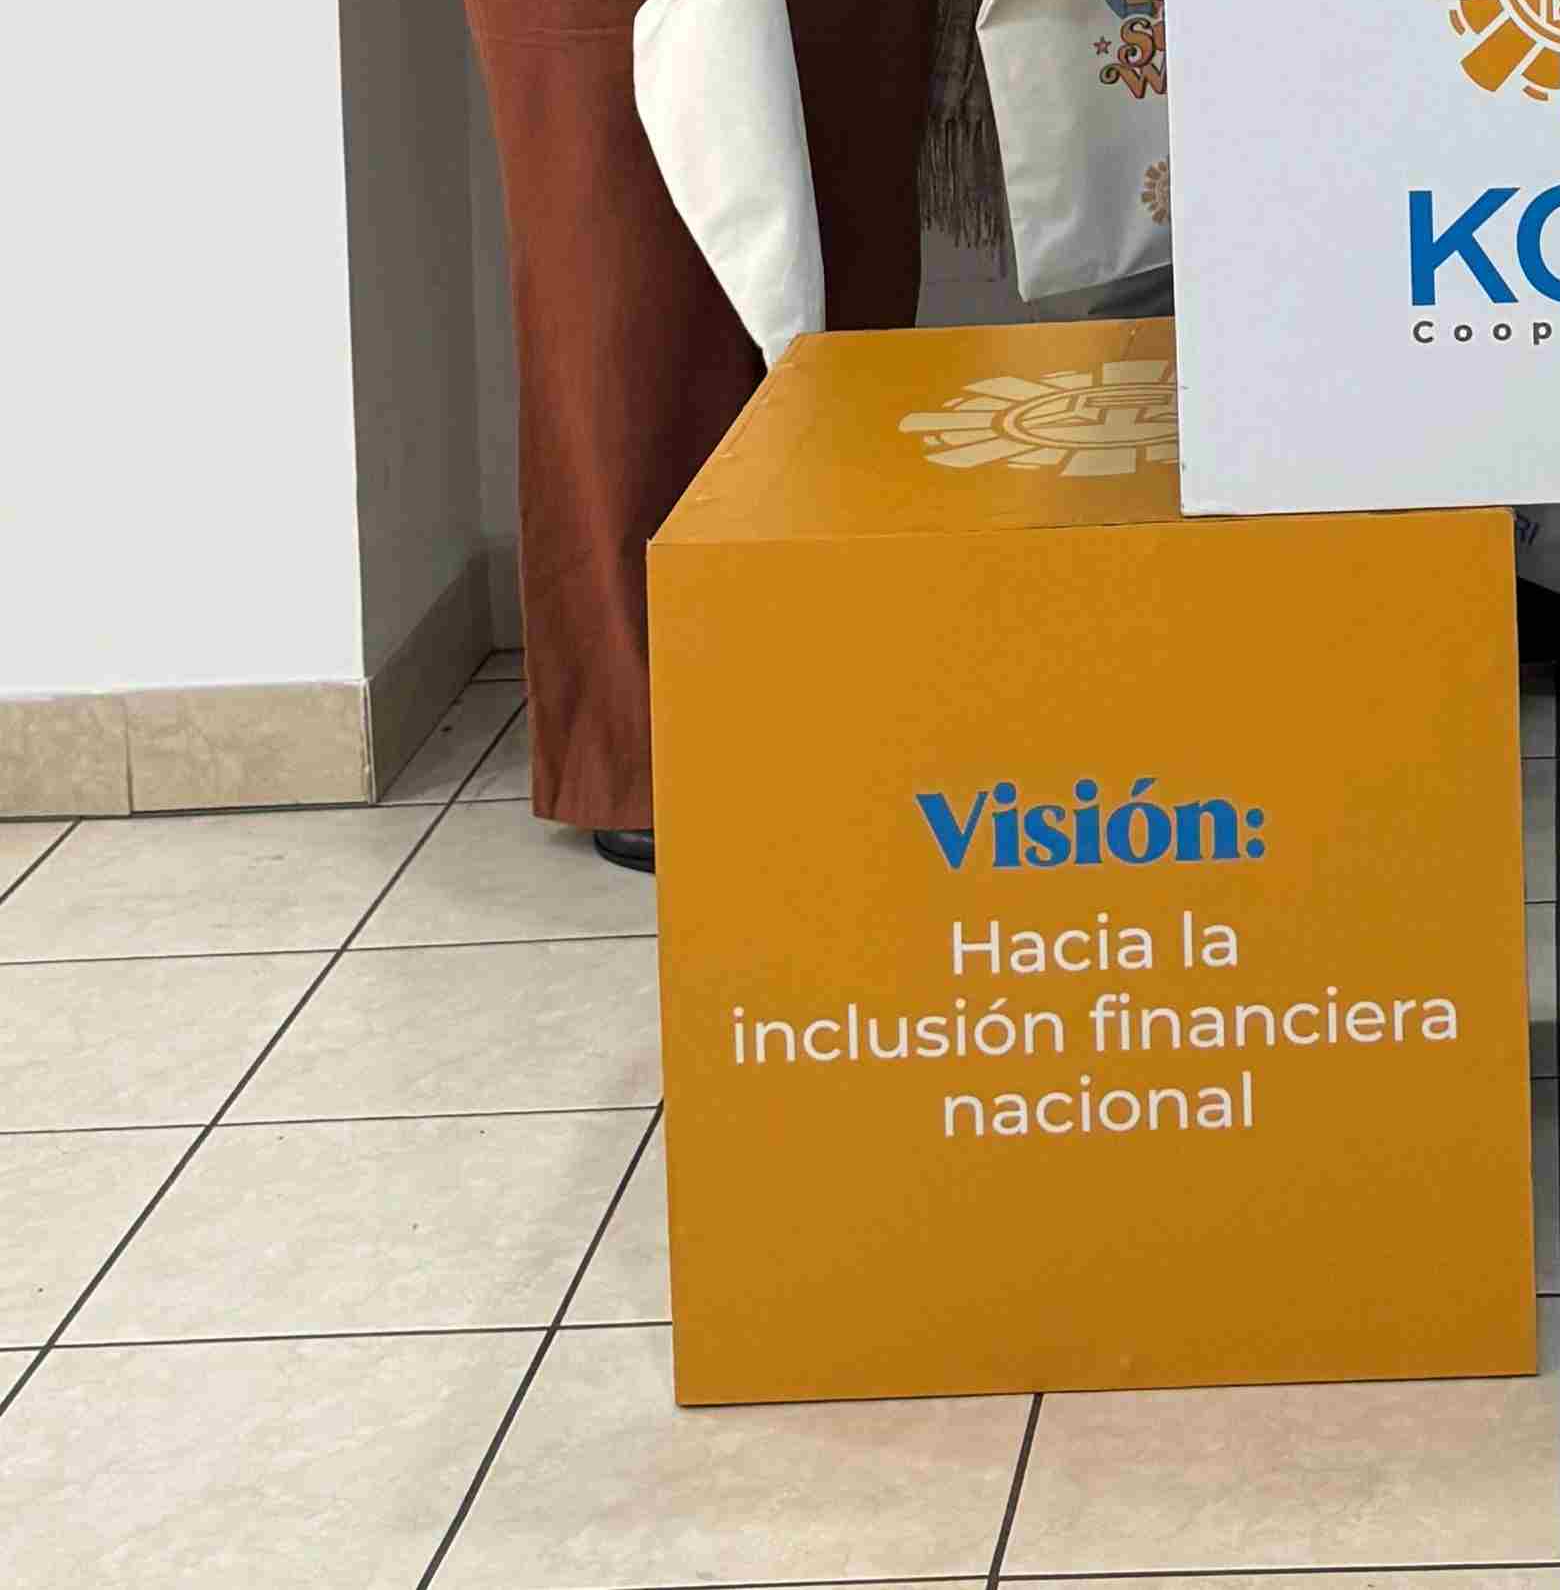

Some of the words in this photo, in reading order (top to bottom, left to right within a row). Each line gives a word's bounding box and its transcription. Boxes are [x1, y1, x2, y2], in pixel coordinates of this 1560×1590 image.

[915, 777, 1266, 870] Visión:
[951, 912, 1154, 975] Hacia
[1182, 910, 1239, 968] la
[732, 998, 1065, 1064] inclusión
[1089, 986, 1459, 1052] financiera
[943, 1071, 1254, 1138] nacional
